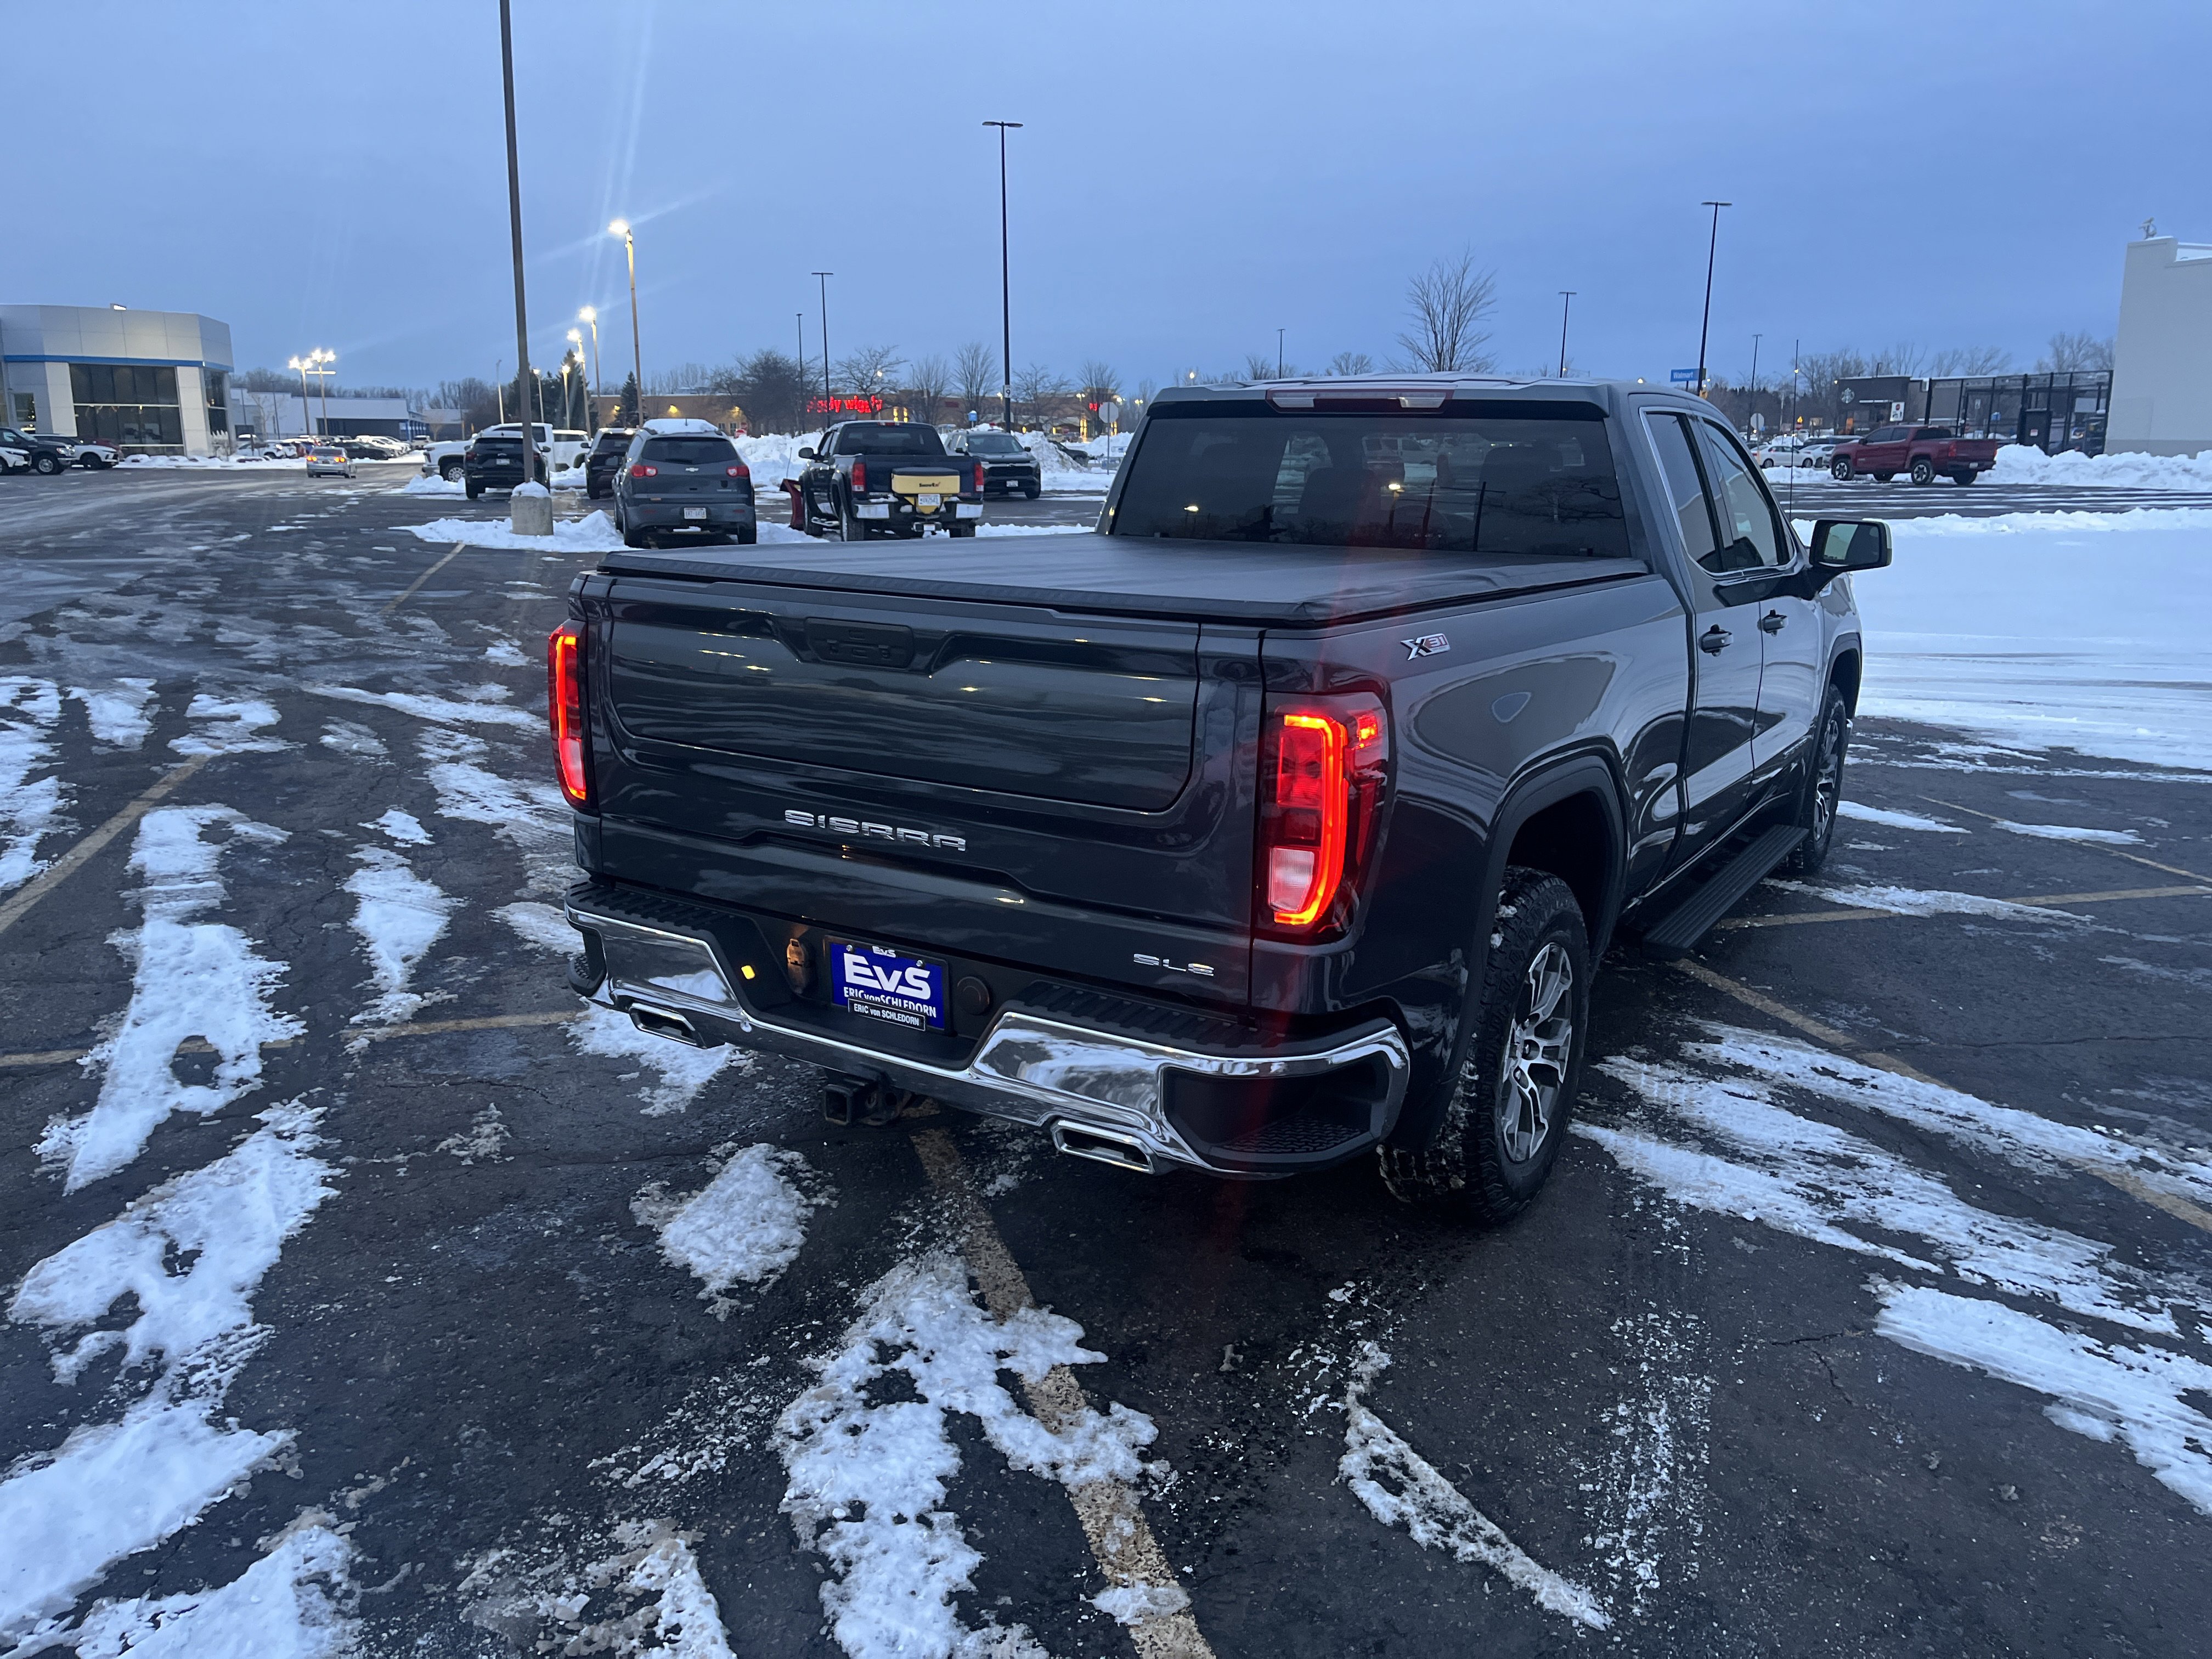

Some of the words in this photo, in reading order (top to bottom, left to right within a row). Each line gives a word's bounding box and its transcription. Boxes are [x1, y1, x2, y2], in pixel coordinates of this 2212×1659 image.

[785, 809, 966, 851] SIERRA
[854, 1003, 868, 1014] ERIC
[870, 1008, 881, 1017] von
[882, 1009, 919, 1026] SCHLEDORN
